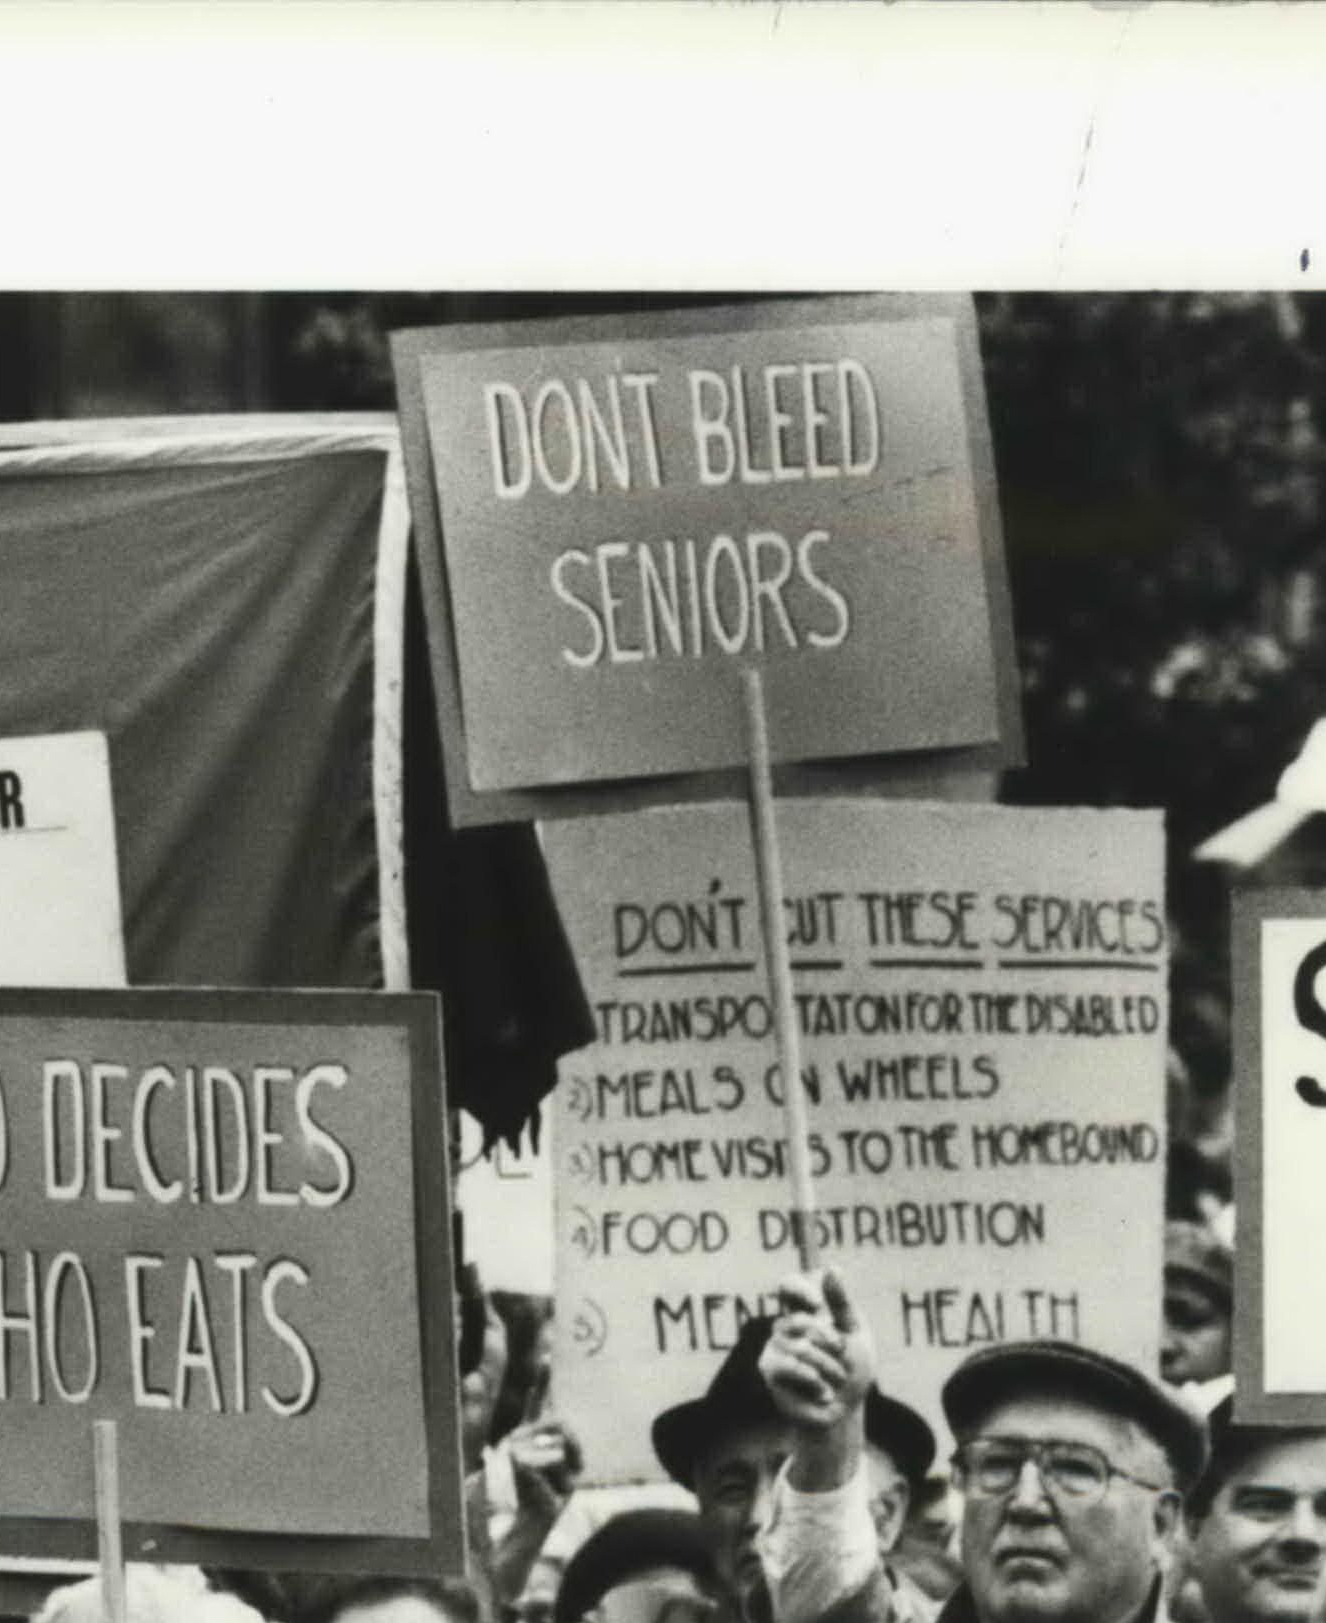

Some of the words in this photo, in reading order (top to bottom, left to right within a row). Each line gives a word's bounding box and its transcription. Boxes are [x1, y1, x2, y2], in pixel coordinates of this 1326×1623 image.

[483, 355, 663, 499] DON'T
[689, 358, 880, 486] BLEED
[550, 531, 849, 667] SENIORS
[615, 877, 745, 957] DON'T
[782, 891, 845, 946] UT
[857, 892, 979, 949] THESE
[992, 895, 1165, 953] SERVICES
[905, 991, 962, 1034] FOR
[969, 993, 1020, 1035] THE
[596, 1066, 746, 1119] MEALS
[837, 1055, 1001, 1102] WHEELS
[42, 1058, 355, 1208] DECIDES
[598, 1138, 709, 1186] HOME
[710, 1132, 832, 1180] VISIS
[837, 1129, 893, 1175] TO
[898, 1123, 960, 1172] THE
[972, 1121, 1159, 1169] HOMEBOUND
[602, 1210, 729, 1255] FOOD
[125, 1253, 318, 1417] EATS
[901, 1289, 1081, 1349] HEALTH
